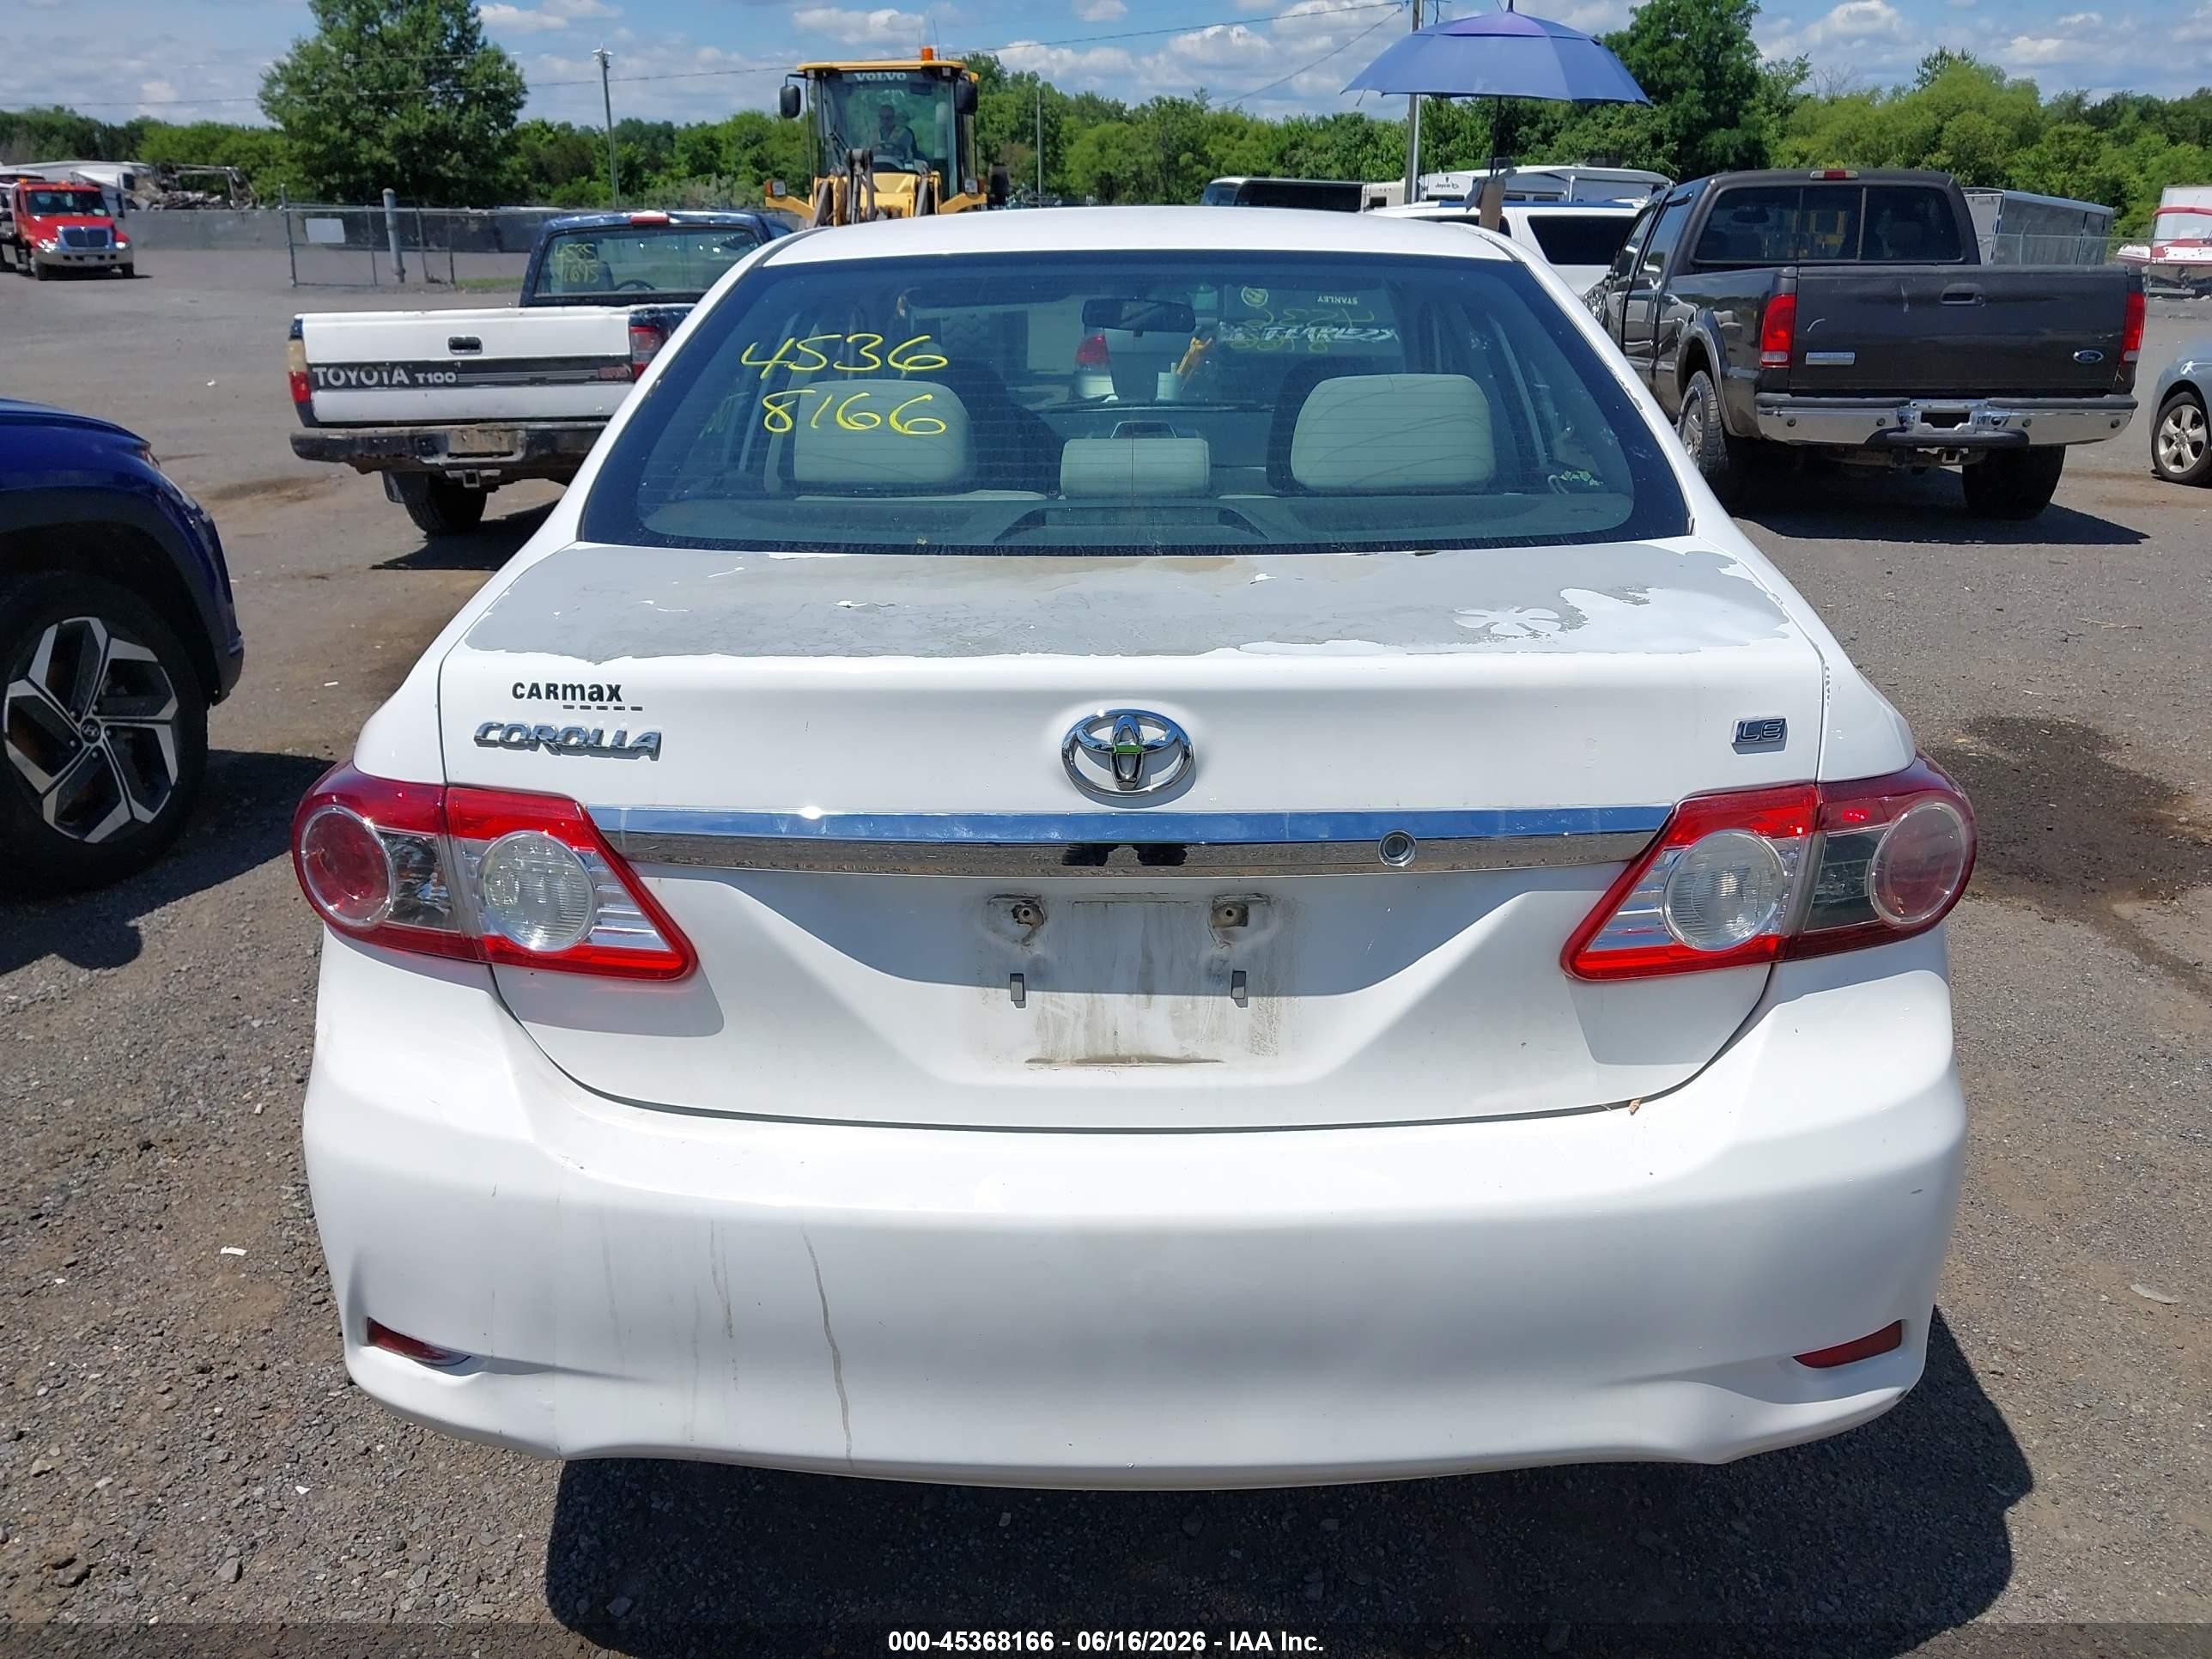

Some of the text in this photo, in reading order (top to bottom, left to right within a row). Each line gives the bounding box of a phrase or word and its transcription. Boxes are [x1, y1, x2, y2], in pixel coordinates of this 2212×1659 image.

[854, 72, 907, 81] VOLVO
[1317, 295, 1358, 306] STANLEY
[740, 332, 949, 380] 4536
[312, 366, 457, 386] TOYOTA T100
[762, 388, 947, 434] 8166
[473, 720, 663, 762] COROLLA
[1739, 719, 1784, 741] LE
